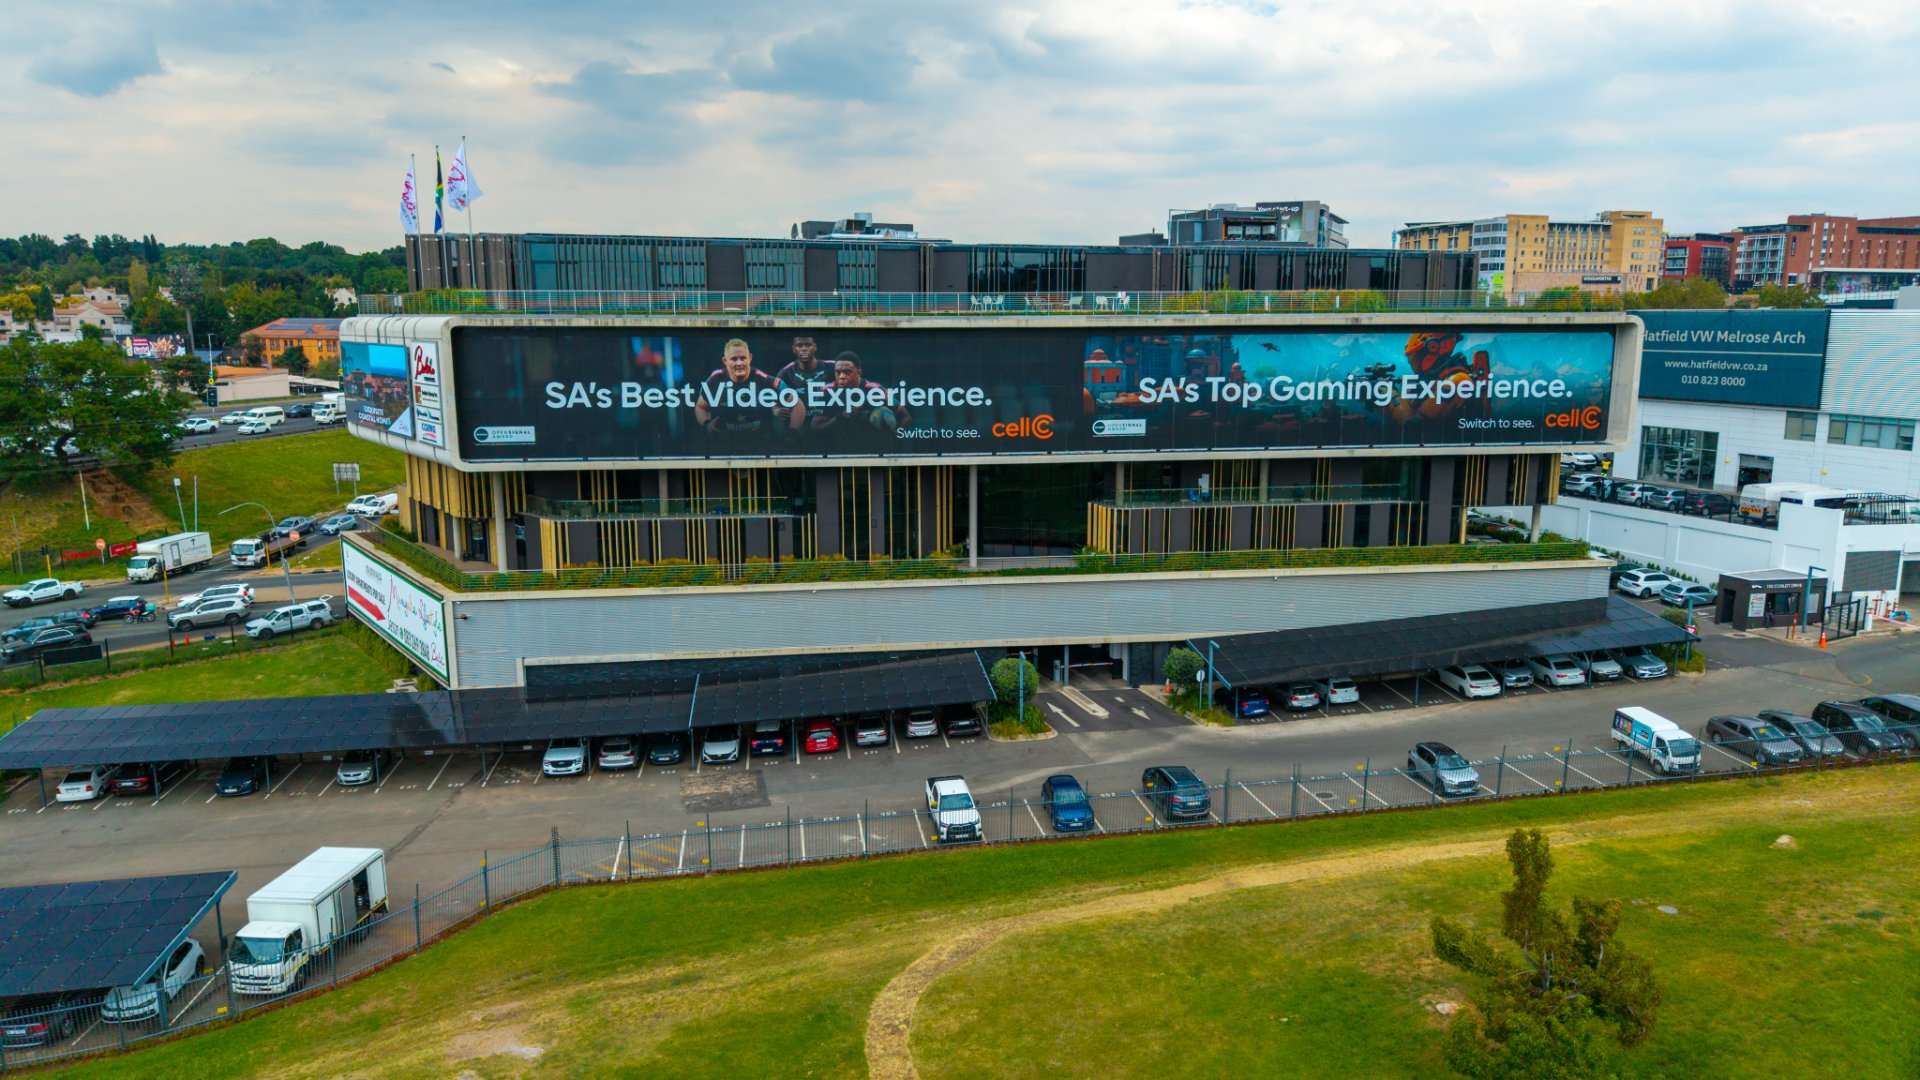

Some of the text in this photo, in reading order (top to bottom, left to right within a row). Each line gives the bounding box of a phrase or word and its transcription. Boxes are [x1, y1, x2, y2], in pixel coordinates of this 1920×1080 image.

[1690, 330, 1715, 342] VW
[1717, 330, 1770, 344] Melrose
[1773, 331, 1806, 344] Arch
[1664, 359, 1768, 372] www.hatfieldvw.co.za
[1681, 375, 1746, 386] 010 823 8000
[545, 380, 992, 414] SA's Best Video Experience.
[1138, 373, 1573, 408] SA's Top Gaming Experience.
[1458, 417, 1535, 429] Switch to see.
[896, 426, 981, 439] Switch to see.
